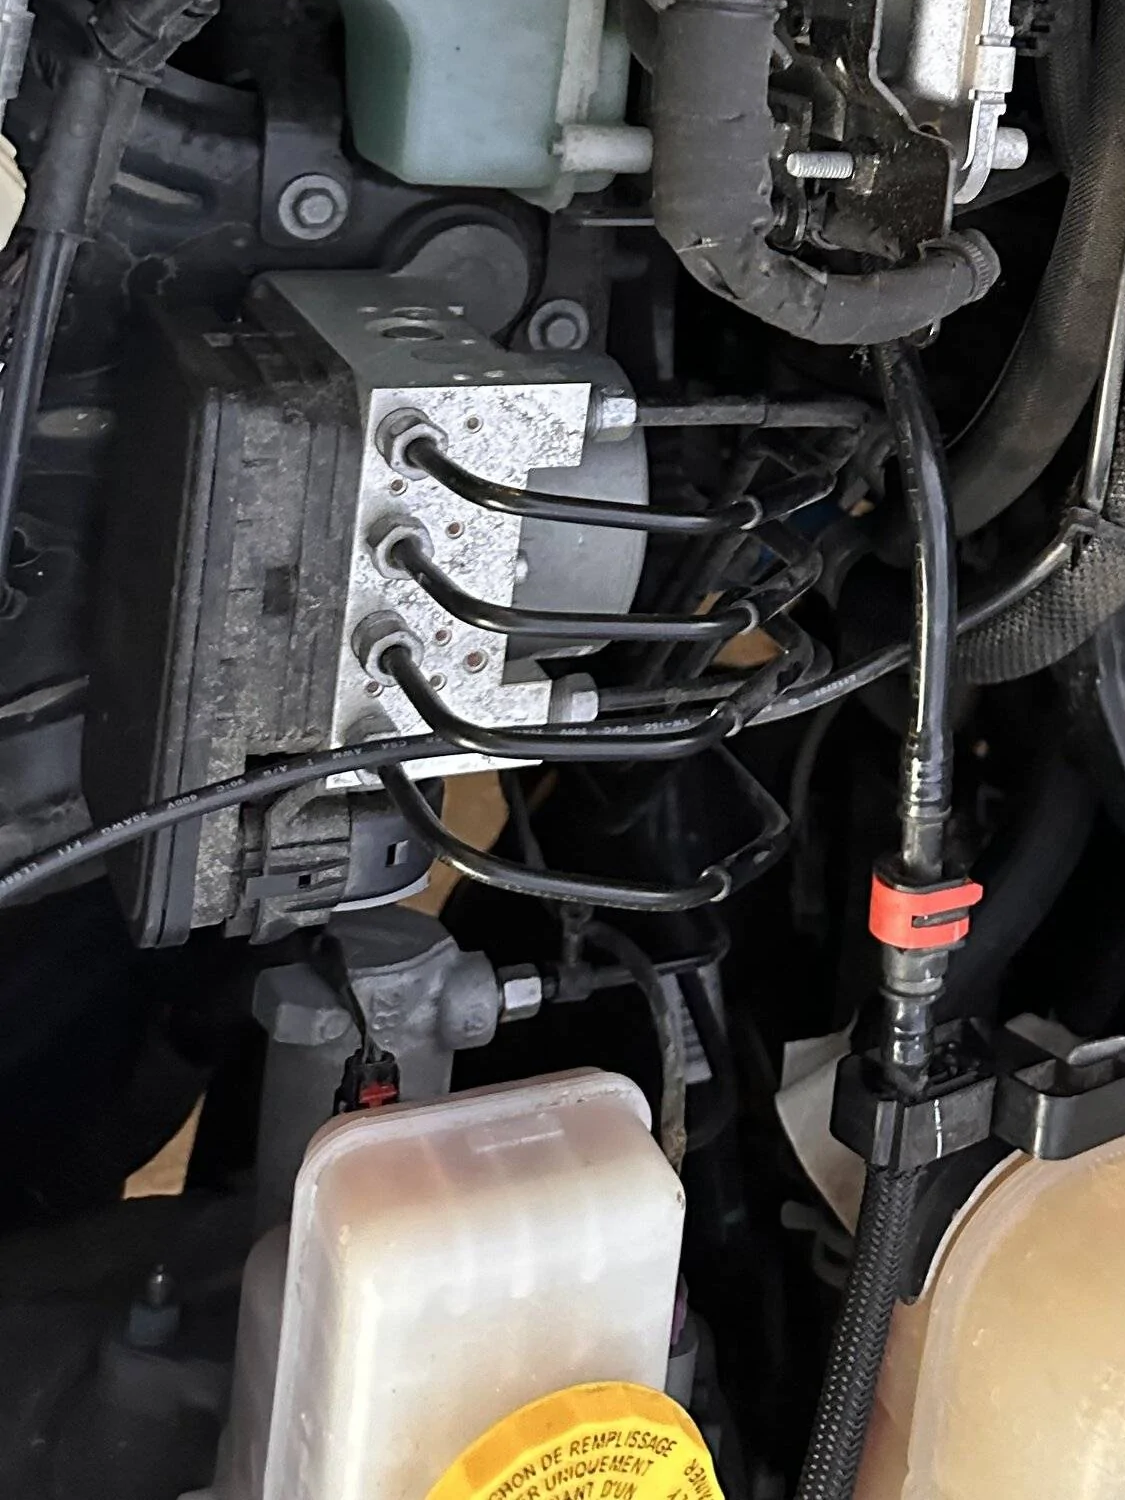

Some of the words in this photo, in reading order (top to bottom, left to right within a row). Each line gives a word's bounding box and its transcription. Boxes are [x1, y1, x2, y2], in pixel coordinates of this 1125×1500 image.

[167, 793, 198, 810] 600V
[101, 811, 149, 837] 20AWG
[487, 1464, 538, 1500] CHON
[540, 1446, 562, 1471] DE
[569, 1430, 678, 1457] REMPLISSAGE
[545, 1454, 655, 1492] UNIQUEMENT
[599, 1479, 638, 1500] D'UN
